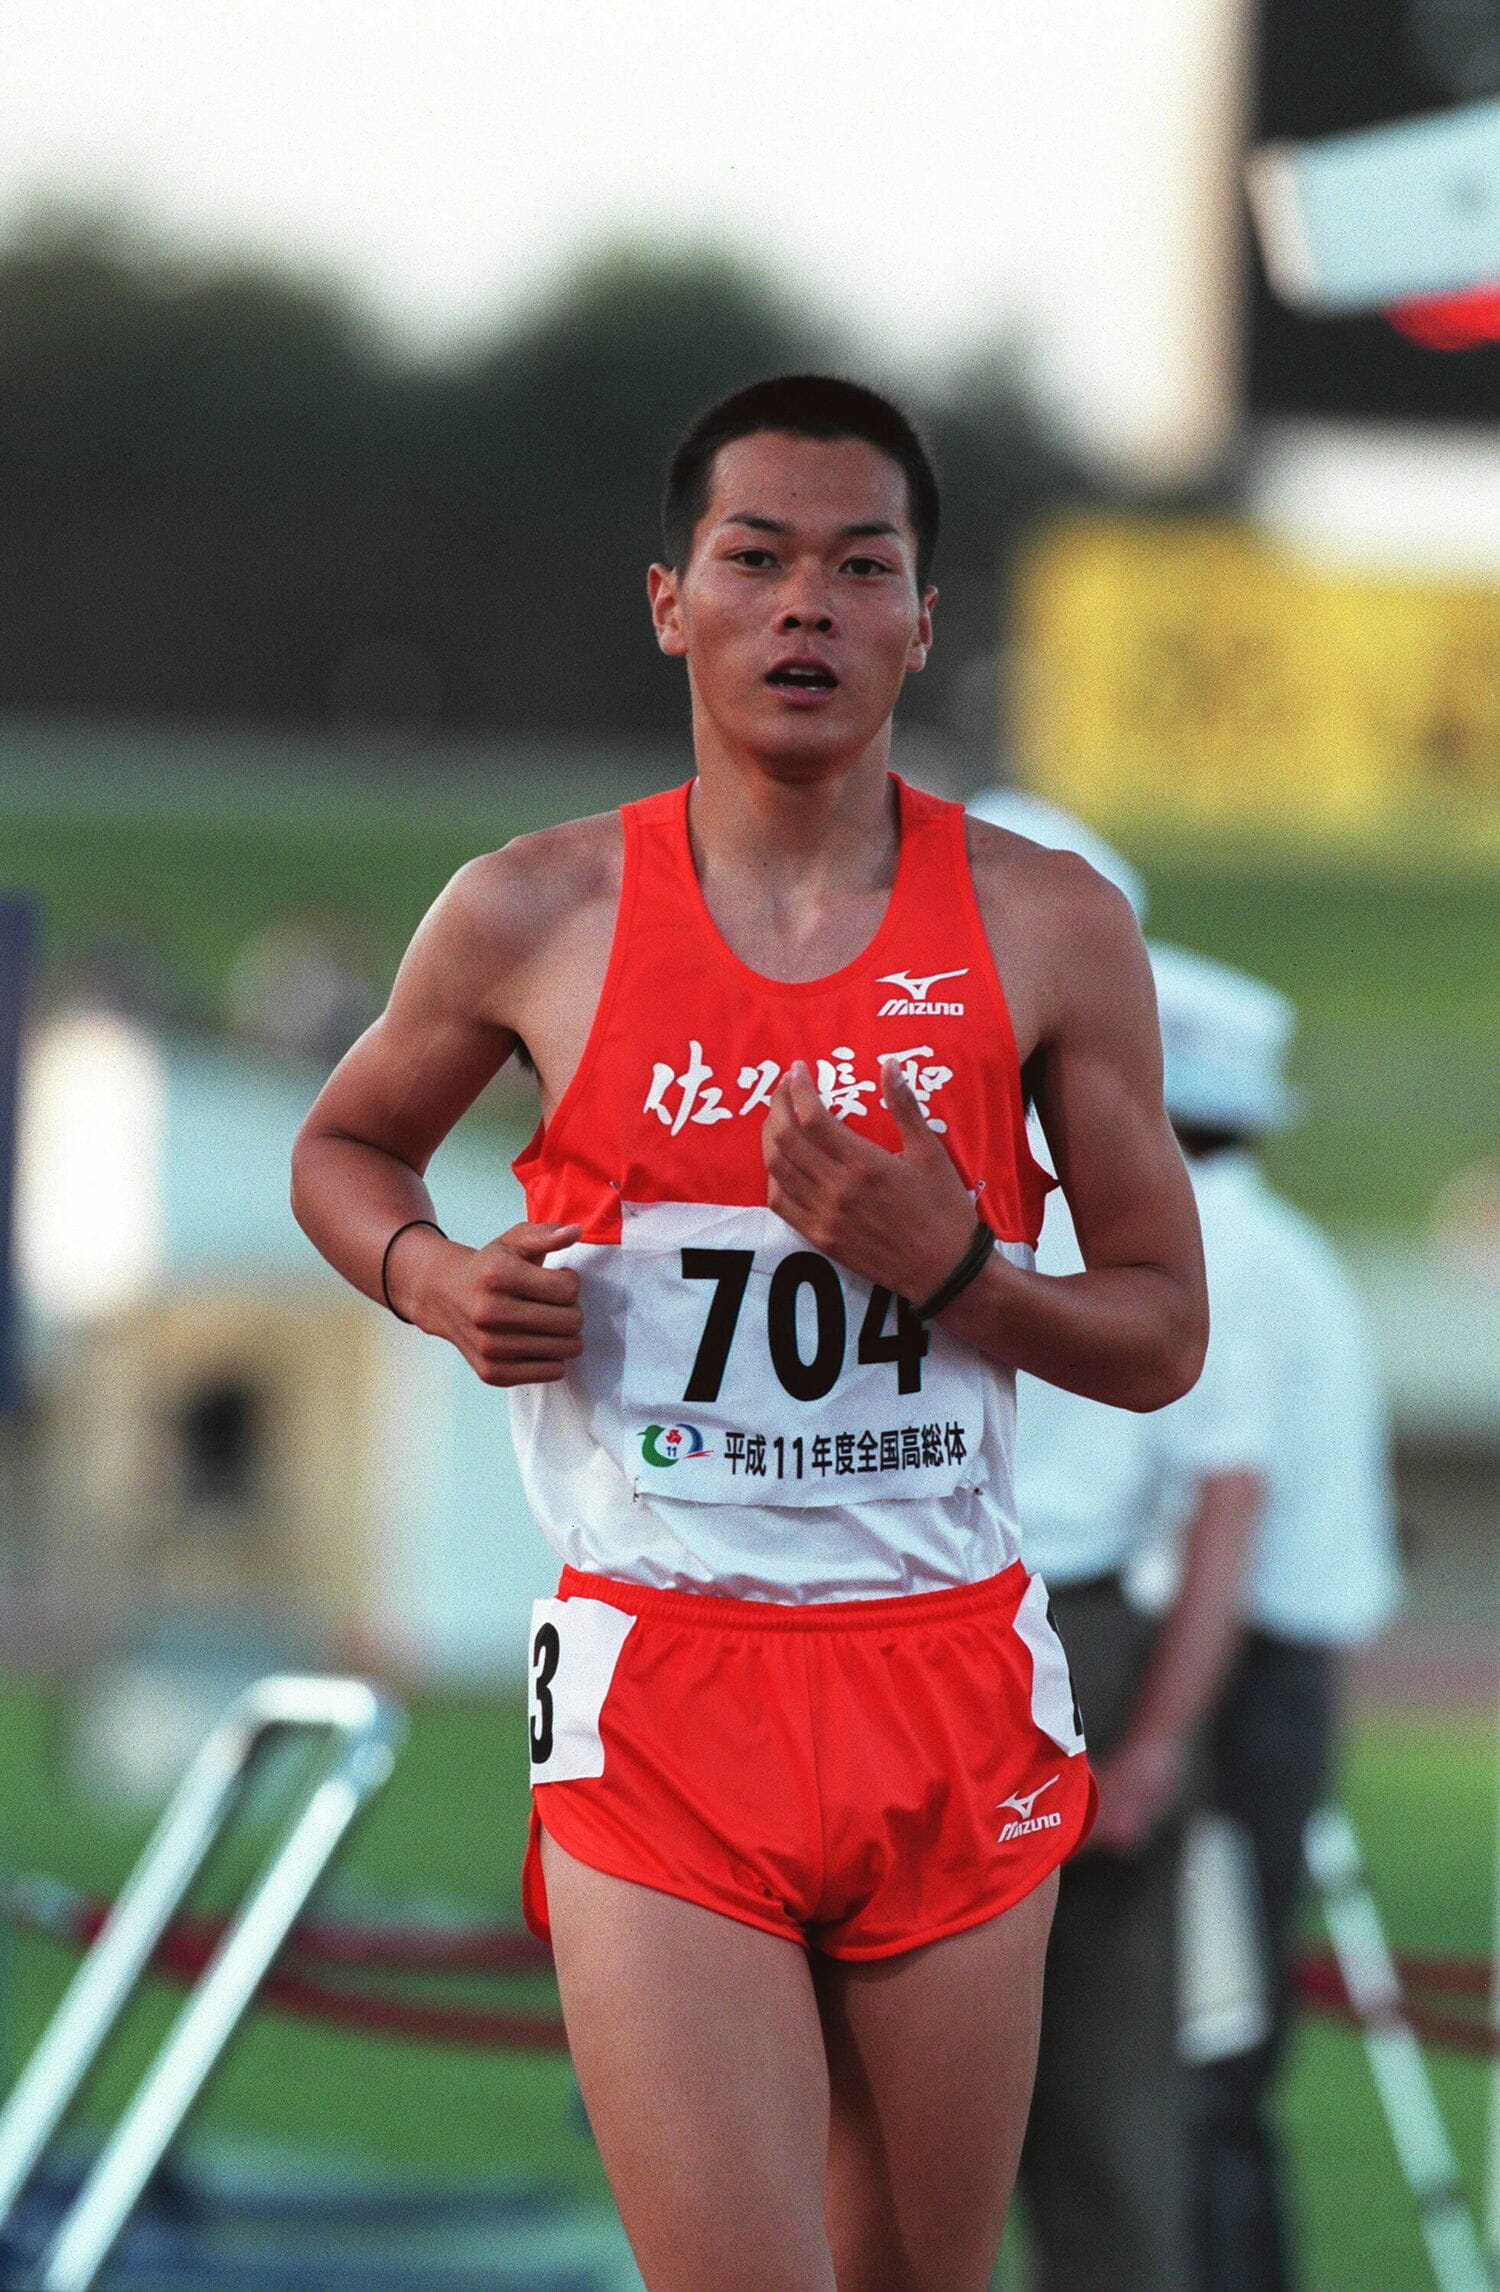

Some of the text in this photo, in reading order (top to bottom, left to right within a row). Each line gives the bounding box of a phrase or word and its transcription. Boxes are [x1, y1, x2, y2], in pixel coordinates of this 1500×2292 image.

[876, 999, 965, 1017] MIZUNO
[681, 1248, 929, 1402] 704
[724, 1421, 967, 1479] 平成11年度全国高総体
[530, 1622, 560, 1764] 3
[998, 1812, 1062, 1842] MIZUNO
